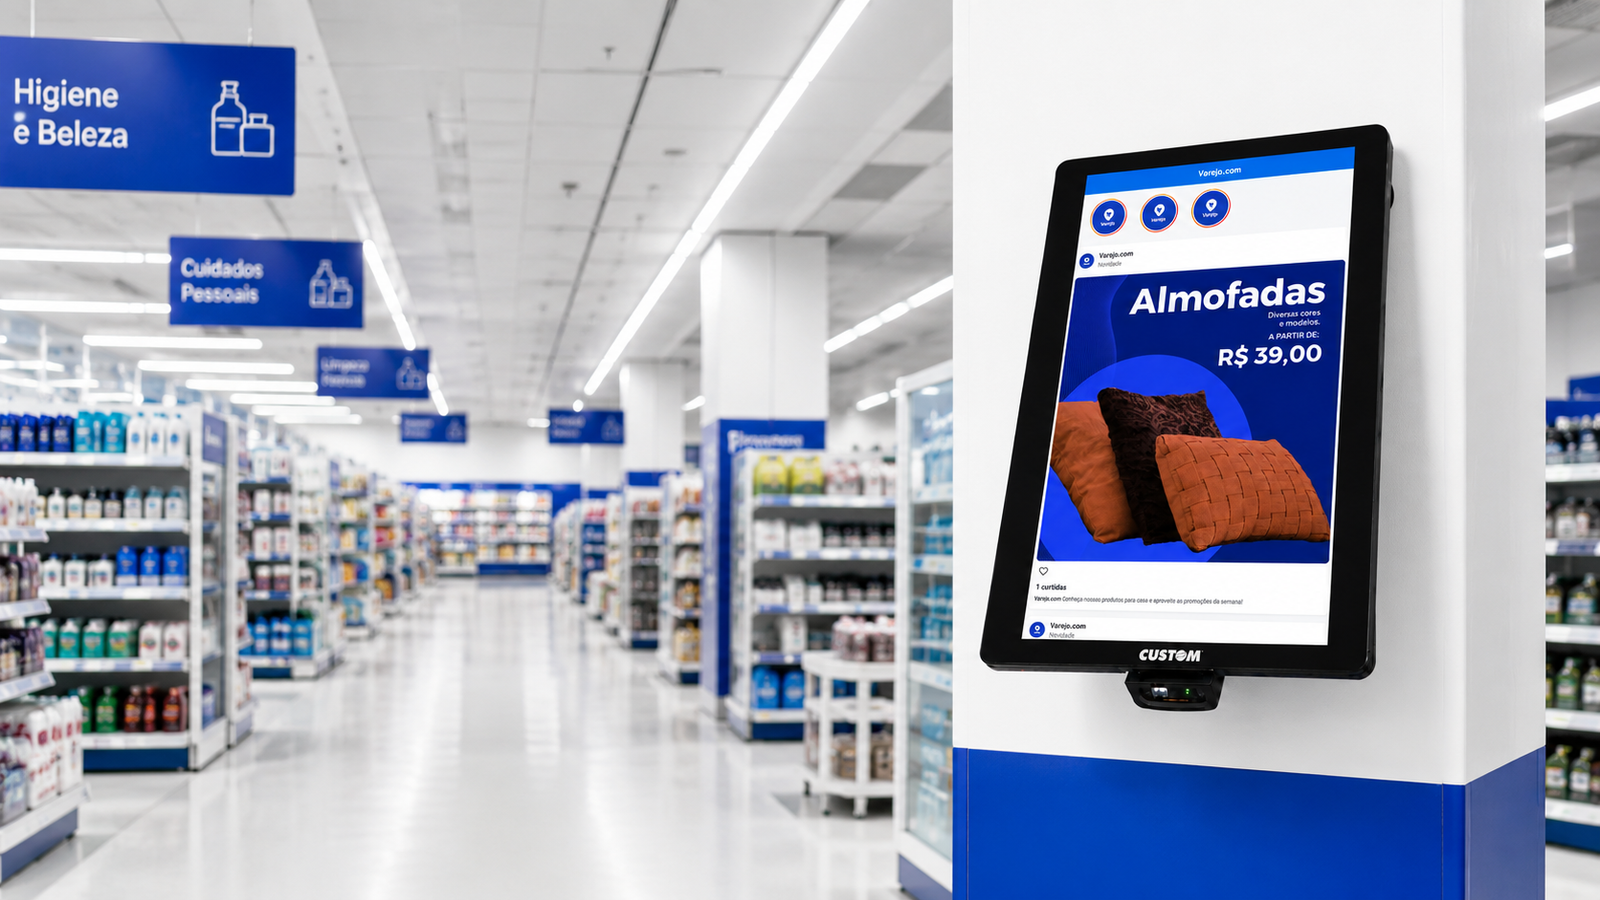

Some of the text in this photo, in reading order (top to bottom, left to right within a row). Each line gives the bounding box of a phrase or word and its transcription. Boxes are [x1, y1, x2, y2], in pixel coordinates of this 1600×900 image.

[15, 78, 119, 112] Higiene
[13, 119, 128, 149] e Beleza
[1198, 167, 1242, 177] Varejo.com
[1098, 251, 1134, 259] Varejo.com
[181, 257, 264, 279] Cuidados
[181, 282, 259, 304] Pessoais
[1129, 278, 1326, 315] Almofadas
[1267, 311, 1299, 319] Diversas
[1268, 330, 1320, 341] A PARTIR DE:
[1218, 344, 1322, 369] R$ 39,00
[1040, 583, 1067, 591] curtidas
[1183, 598, 1212, 606] promoções
[1050, 622, 1087, 631] Varejo.com
[1139, 649, 1201, 662] CUSTOM
